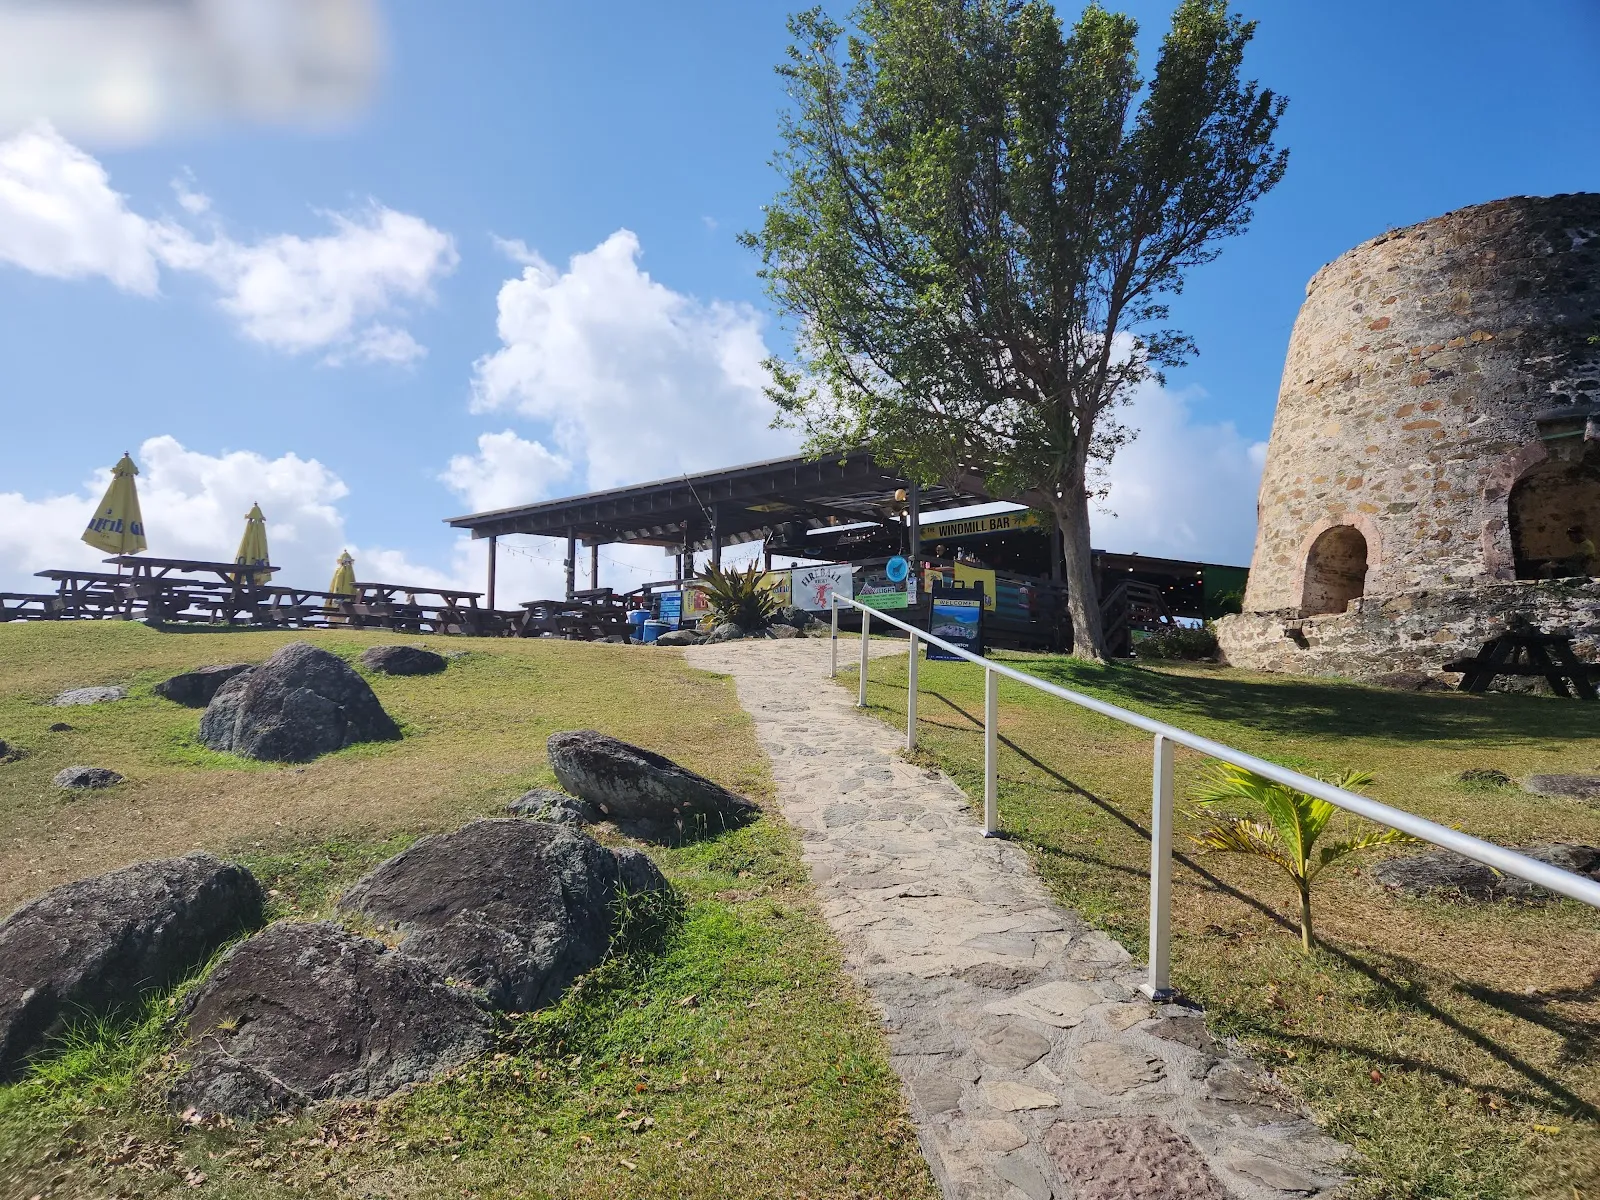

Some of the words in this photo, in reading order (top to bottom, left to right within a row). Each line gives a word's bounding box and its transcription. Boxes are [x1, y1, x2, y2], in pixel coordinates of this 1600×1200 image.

[939, 521, 987, 537] WINDMILL
[989, 516, 1010, 530] BAR
[801, 568, 842, 587] FIREBALL
